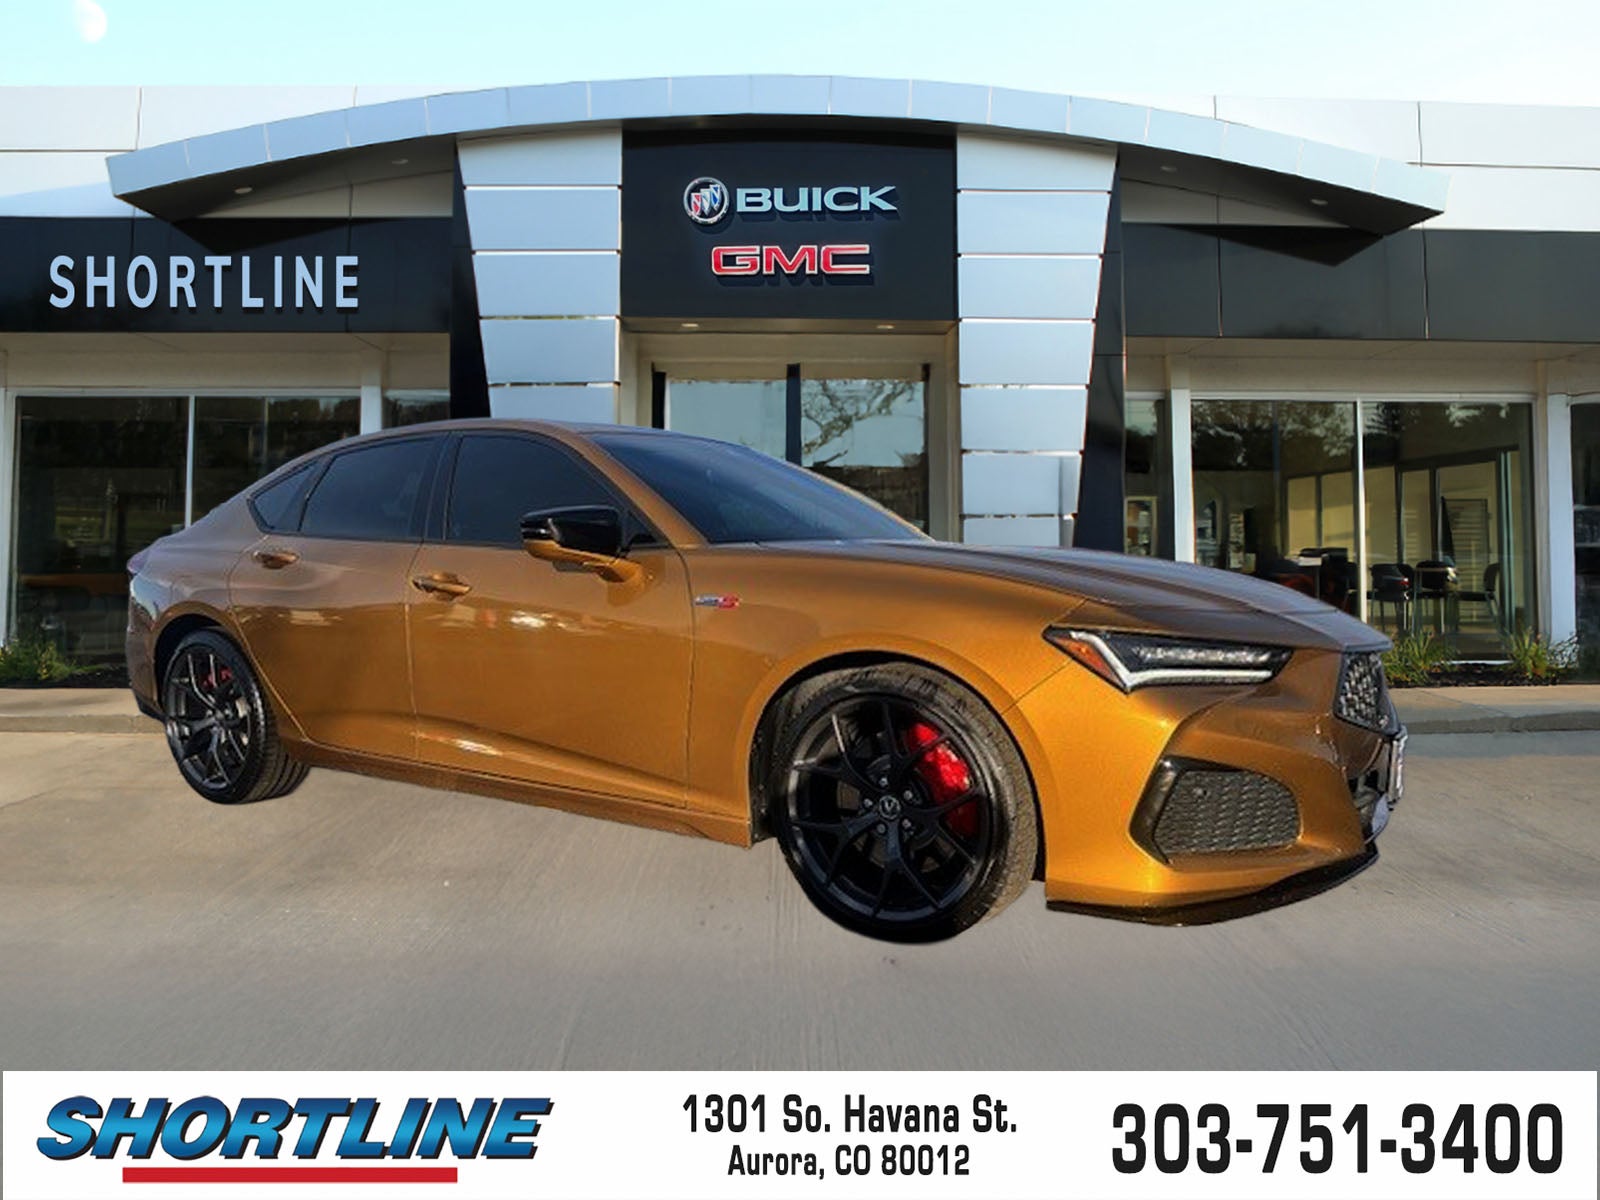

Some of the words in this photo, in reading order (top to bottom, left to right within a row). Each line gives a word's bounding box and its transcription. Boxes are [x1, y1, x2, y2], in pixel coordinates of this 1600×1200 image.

[736, 186, 898, 213] BUICK
[711, 244, 870, 276] GMC
[49, 255, 359, 309] SHORTLINE
